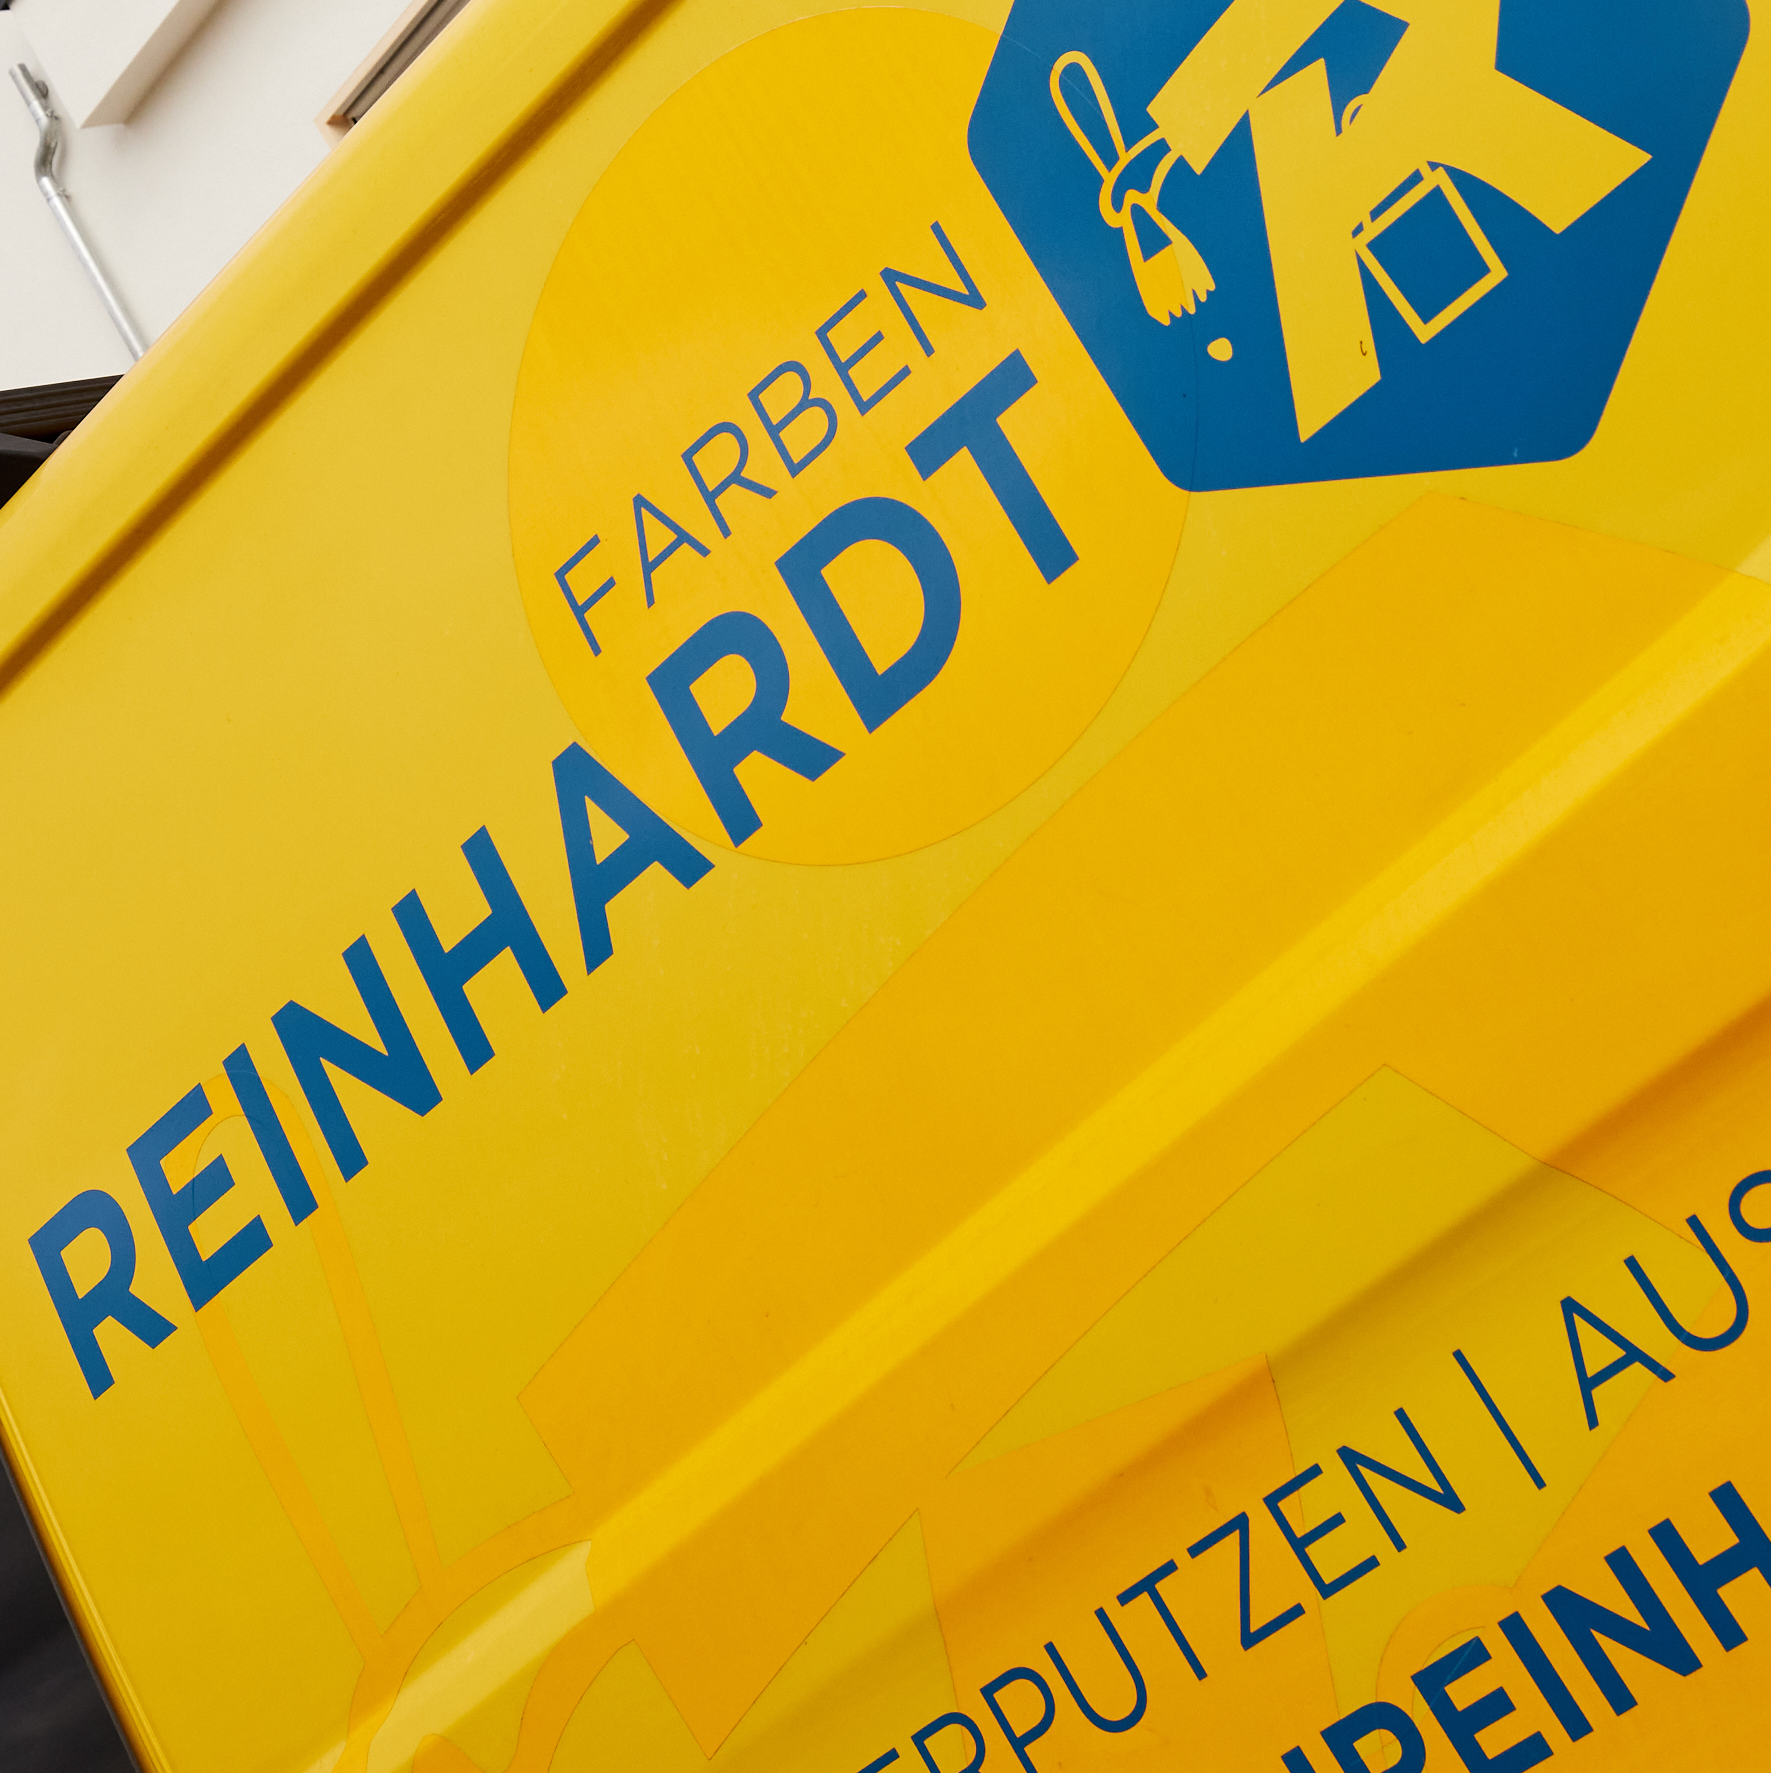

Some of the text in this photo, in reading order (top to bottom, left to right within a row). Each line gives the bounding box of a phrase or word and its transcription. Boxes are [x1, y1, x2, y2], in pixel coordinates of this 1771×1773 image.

[553, 220, 988, 657] FARBEN
[27, 347, 1079, 1400] REINHARDT
[857, 1406, 1467, 1773] RPUTZEN
